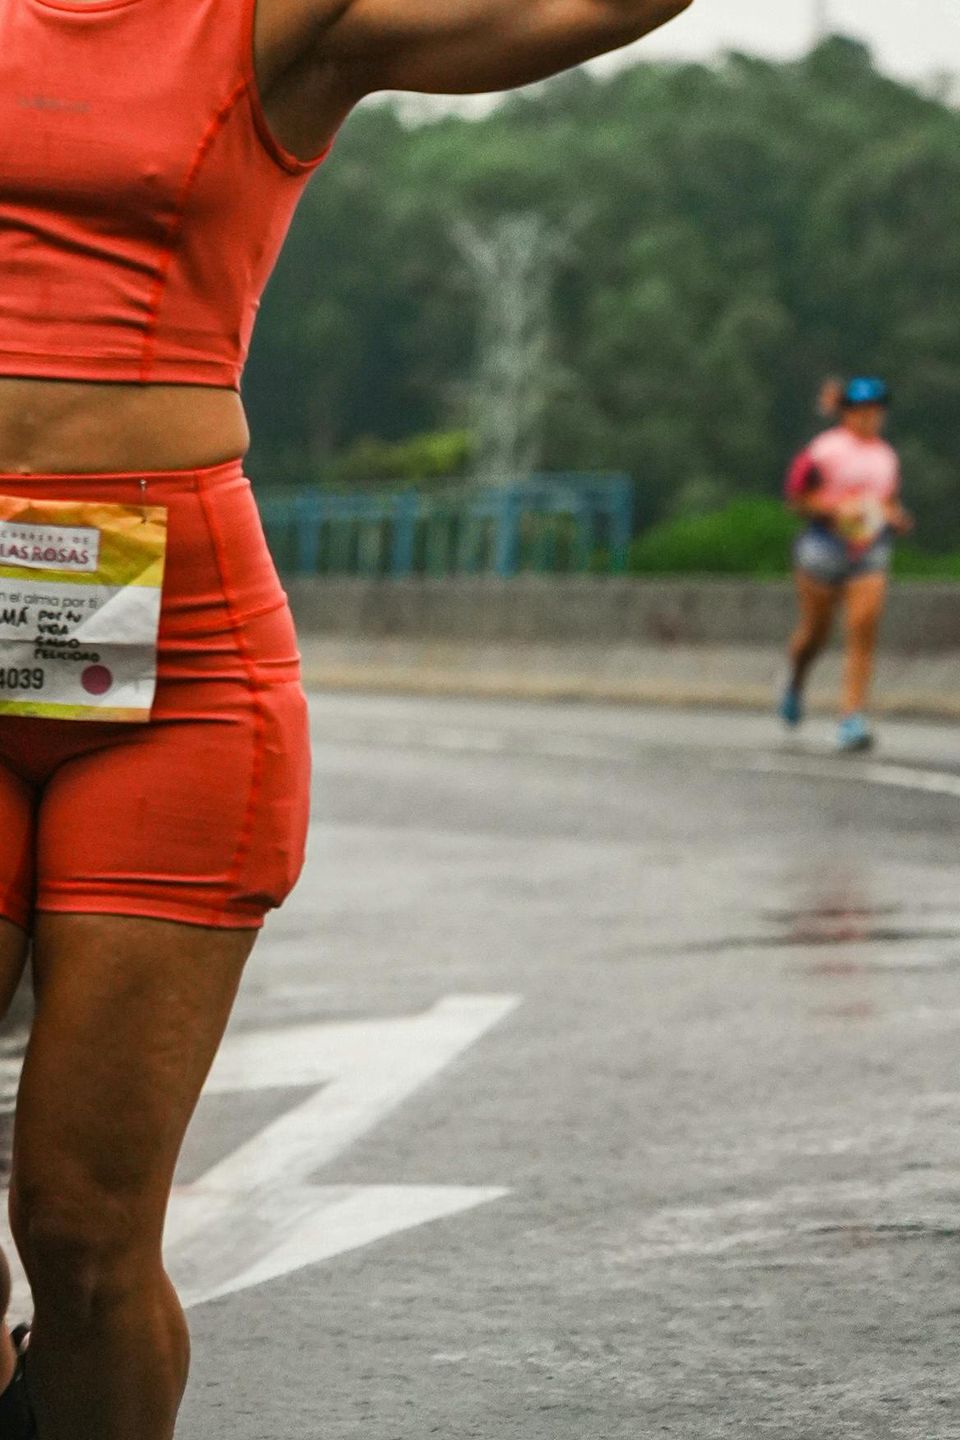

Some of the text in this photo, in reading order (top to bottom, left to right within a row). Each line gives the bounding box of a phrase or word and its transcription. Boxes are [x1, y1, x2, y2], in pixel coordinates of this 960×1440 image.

[0, 543, 89, 565] LAS ROSAS
[9, 592, 20, 603] el
[24, 594, 59, 606] alma
[62, 597, 85, 608] por
